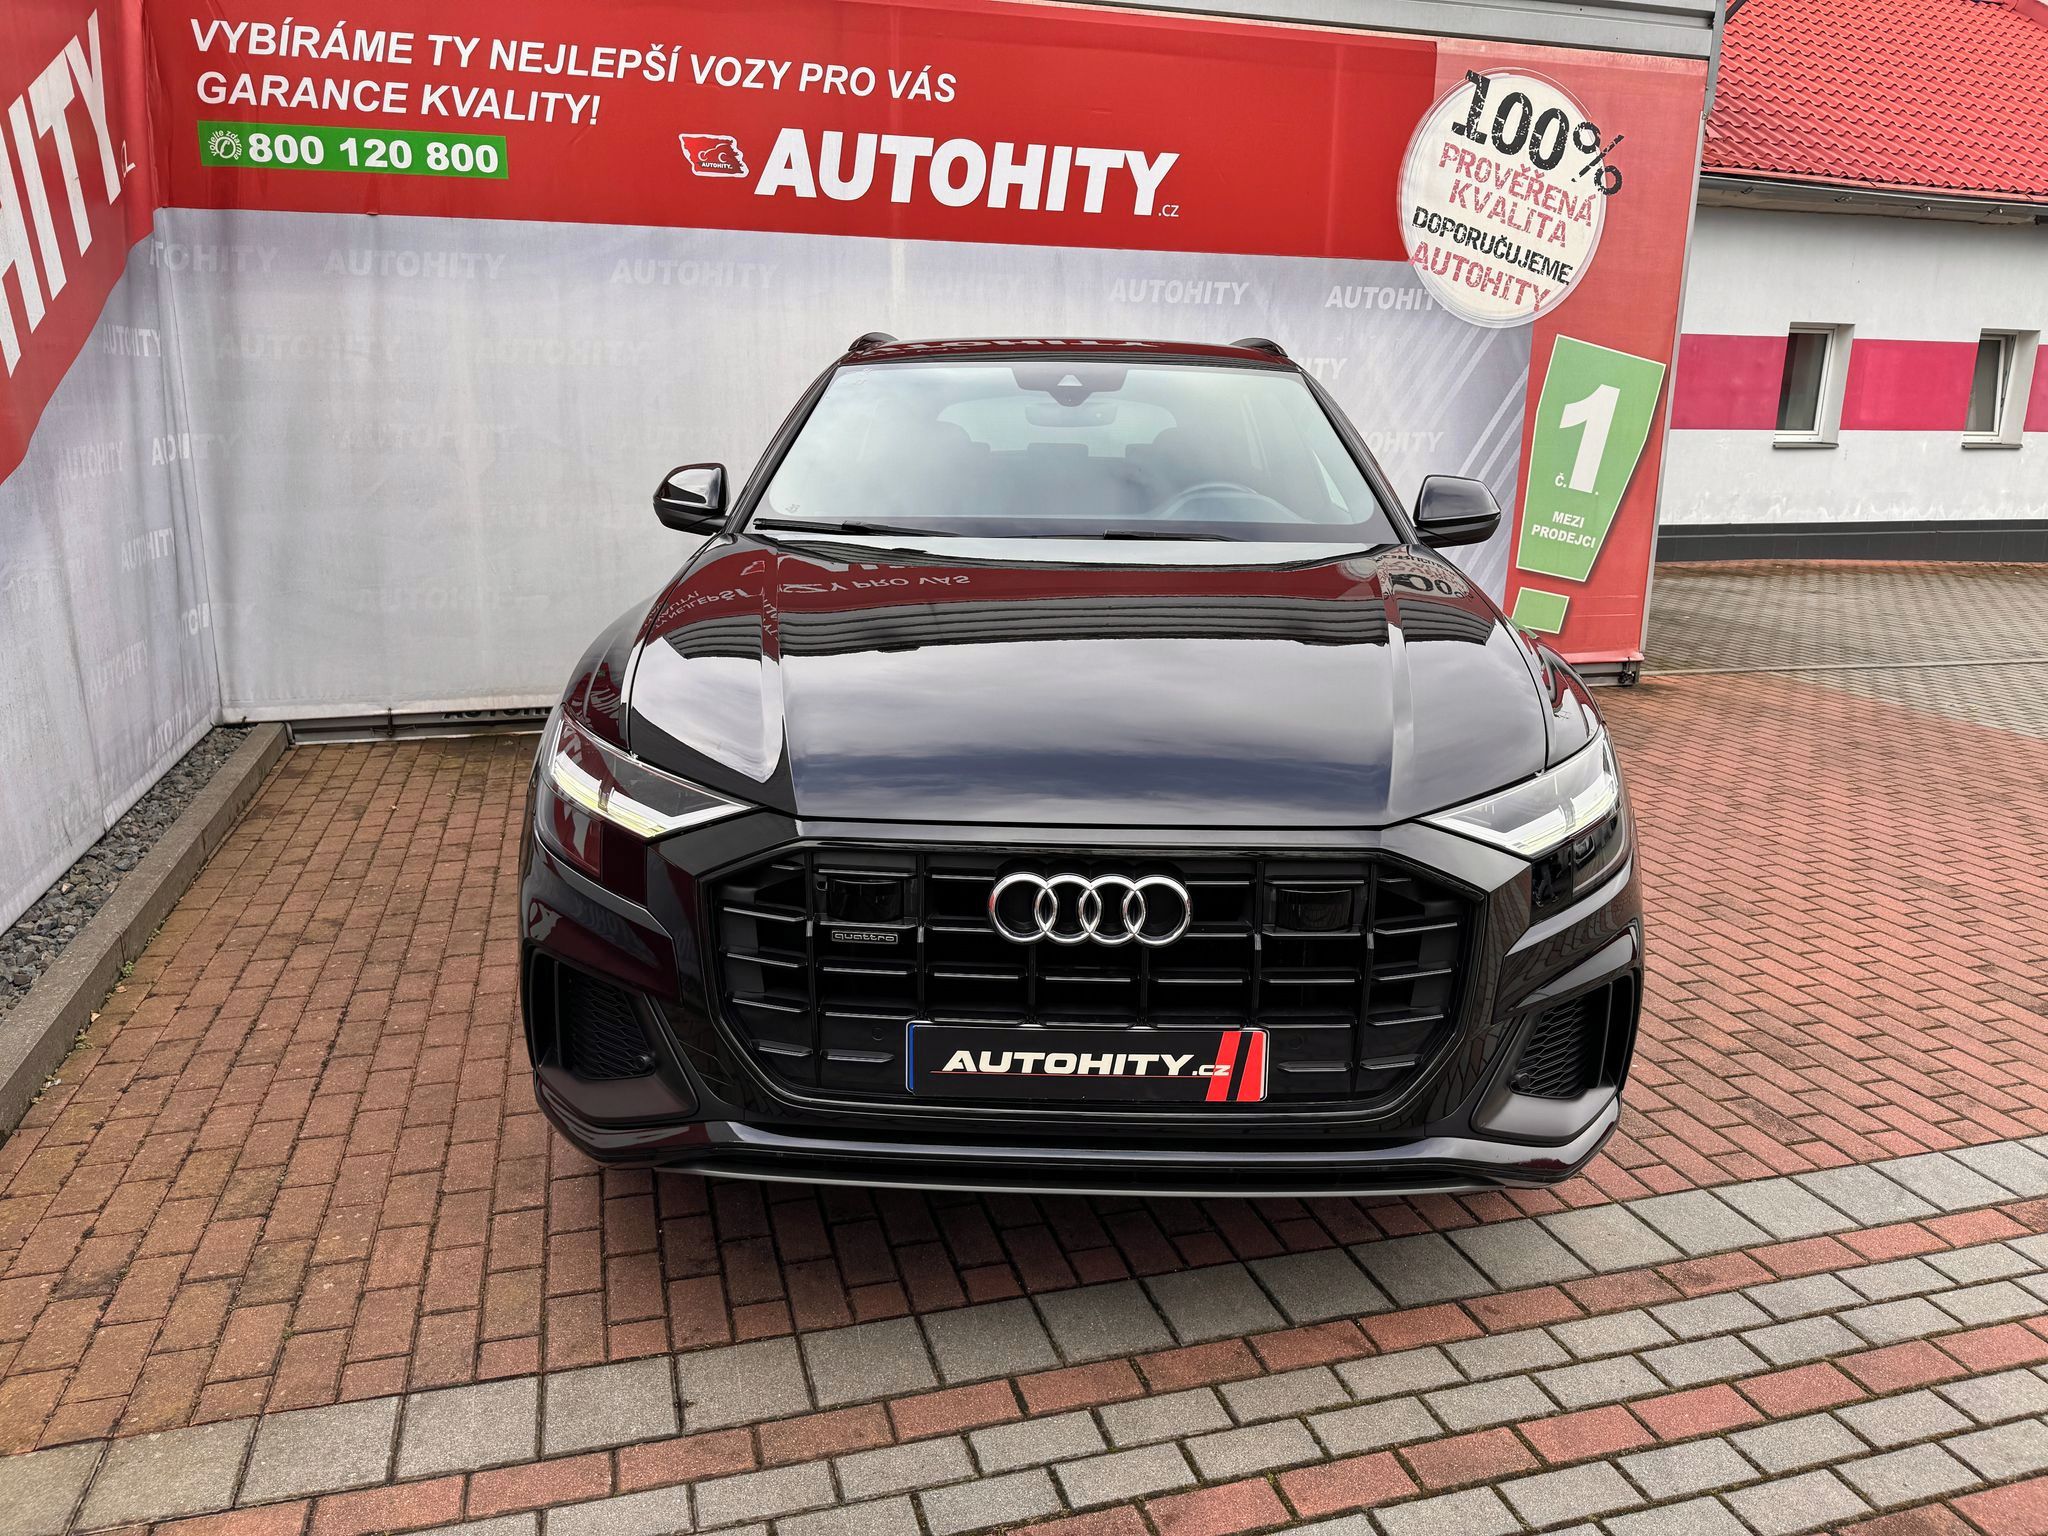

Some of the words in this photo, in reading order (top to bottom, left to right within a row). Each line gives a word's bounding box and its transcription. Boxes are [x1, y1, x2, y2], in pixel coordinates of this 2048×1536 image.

[190, 16, 414, 65] VYBÍRÁME
[428, 34, 479, 68] TY
[489, 40, 682, 82] NEJLEPŠÍ
[690, 54, 792, 90] VOZY
[799, 63, 876, 97] PRO
[888, 65, 958, 103] VÁS
[196, 71, 408, 114] GARANCE
[421, 85, 601, 126] KVALITY!
[248, 132, 324, 165] 800
[339, 137, 412, 169] 120
[426, 142, 499, 174] 800
[1451, 69, 1625, 195] 100%
[1438, 142, 1597, 227] PROVĚŘENÁ
[1448, 179, 1567, 248] KVALITA
[322, 248, 506, 281] AUTOHITY
[1412, 205, 1574, 286] DOPORUČUJEME
[609, 258, 777, 289] AUTOHITY
[1108, 278, 1250, 305] AUTOHITY
[1410, 241, 1551, 312] AUTOHITY
[1325, 286, 1448, 311] AUTOHIT
[1531, 523, 1596, 548] PRODEJCI
[1552, 511, 1585, 529] MEZI
[833, 932, 896, 942] quattro
